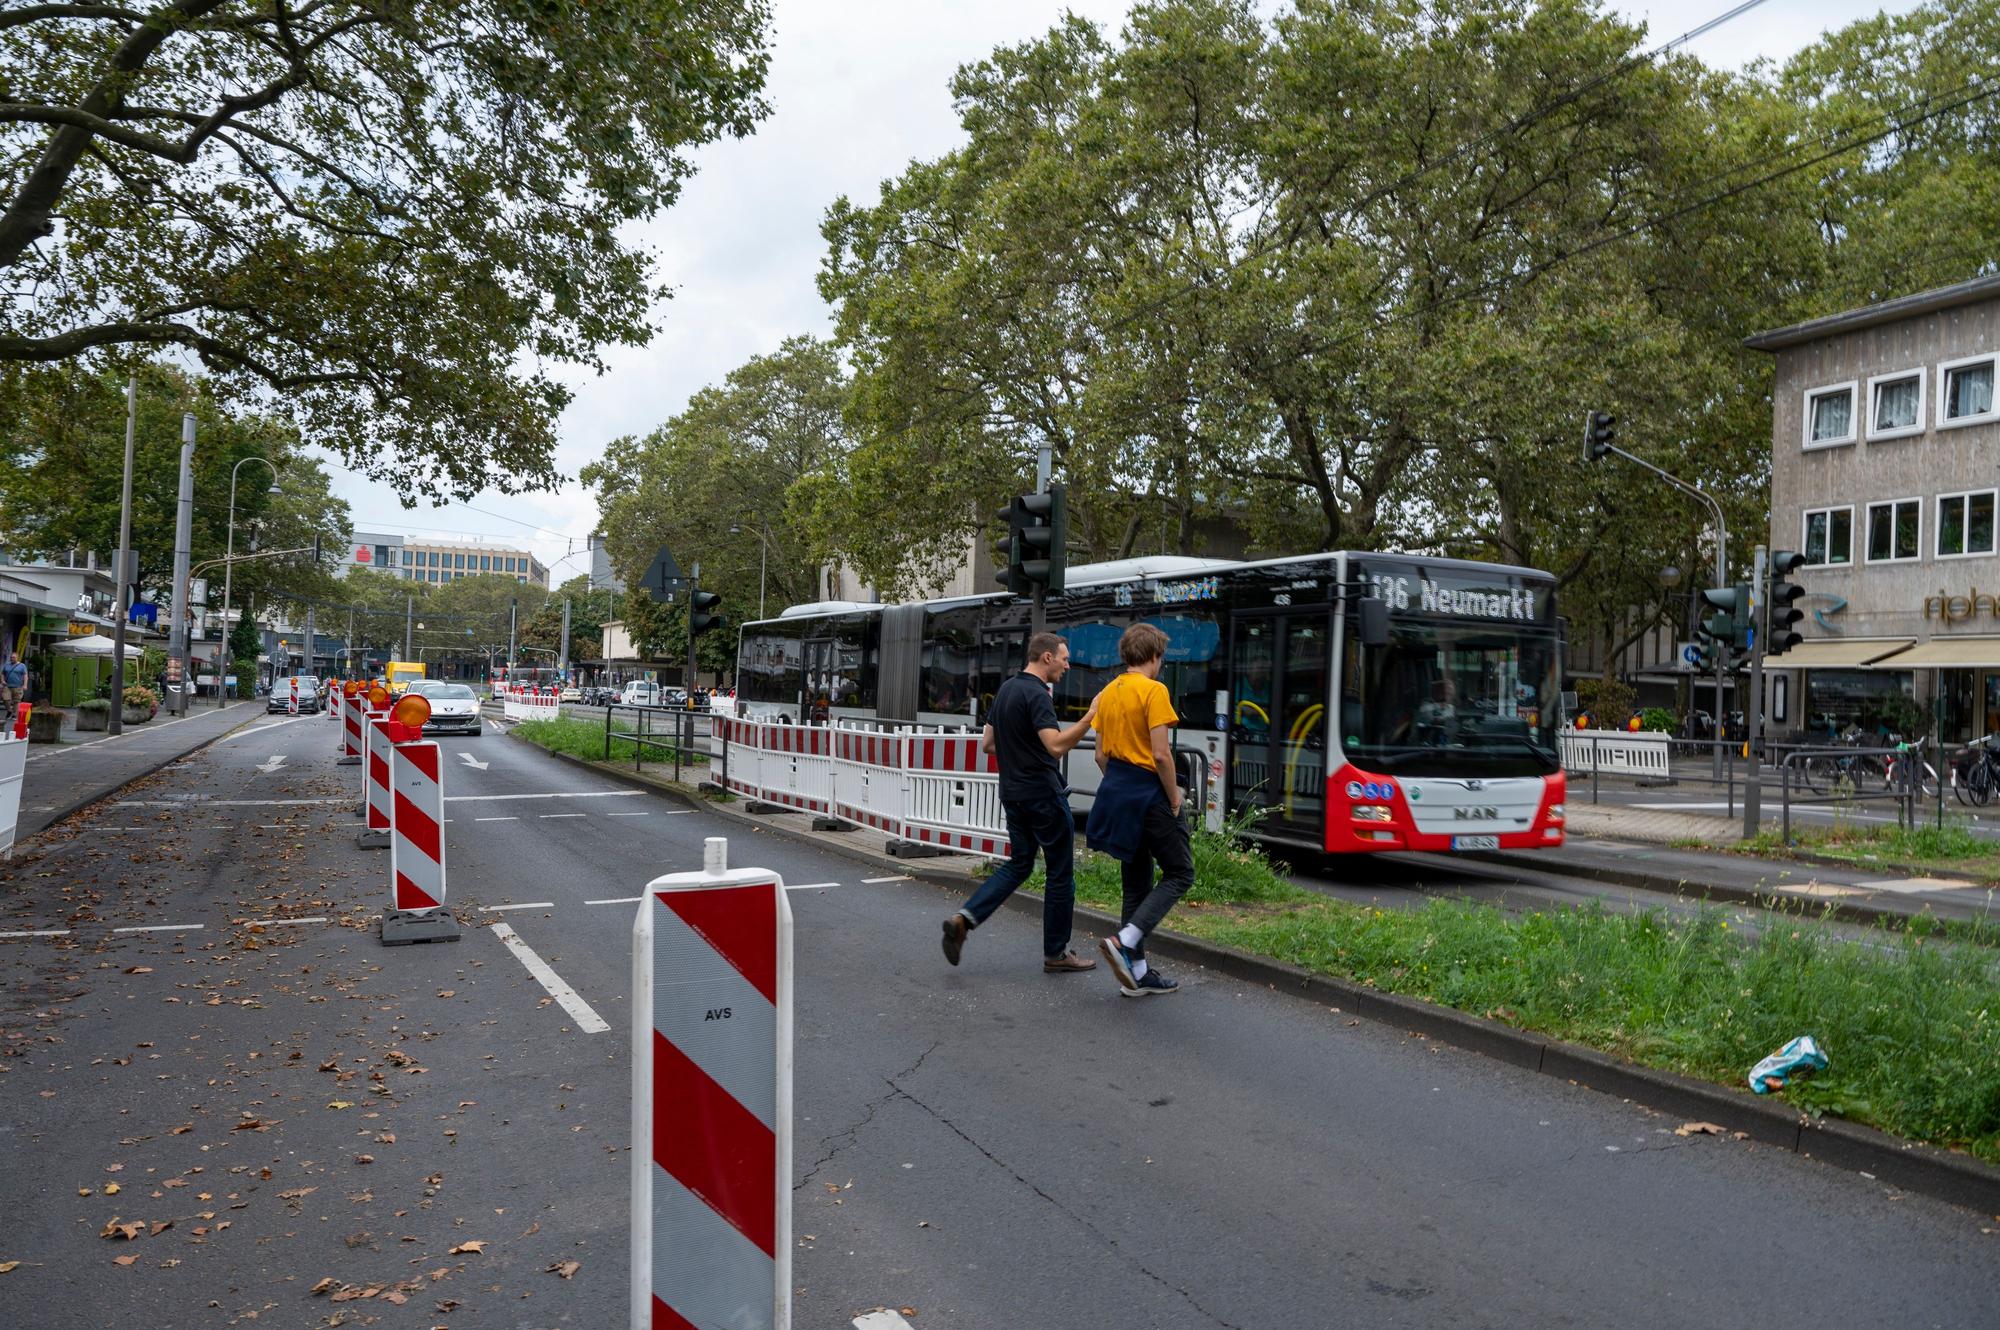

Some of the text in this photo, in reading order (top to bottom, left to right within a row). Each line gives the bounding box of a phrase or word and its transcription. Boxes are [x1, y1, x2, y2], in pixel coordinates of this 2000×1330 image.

[1153, 576, 1218, 603] Neumarkt
[1372, 575, 1535, 620] 136 Neumarkt
[1924, 586, 2000, 629] riph
[705, 1007, 732, 1021] AVS
